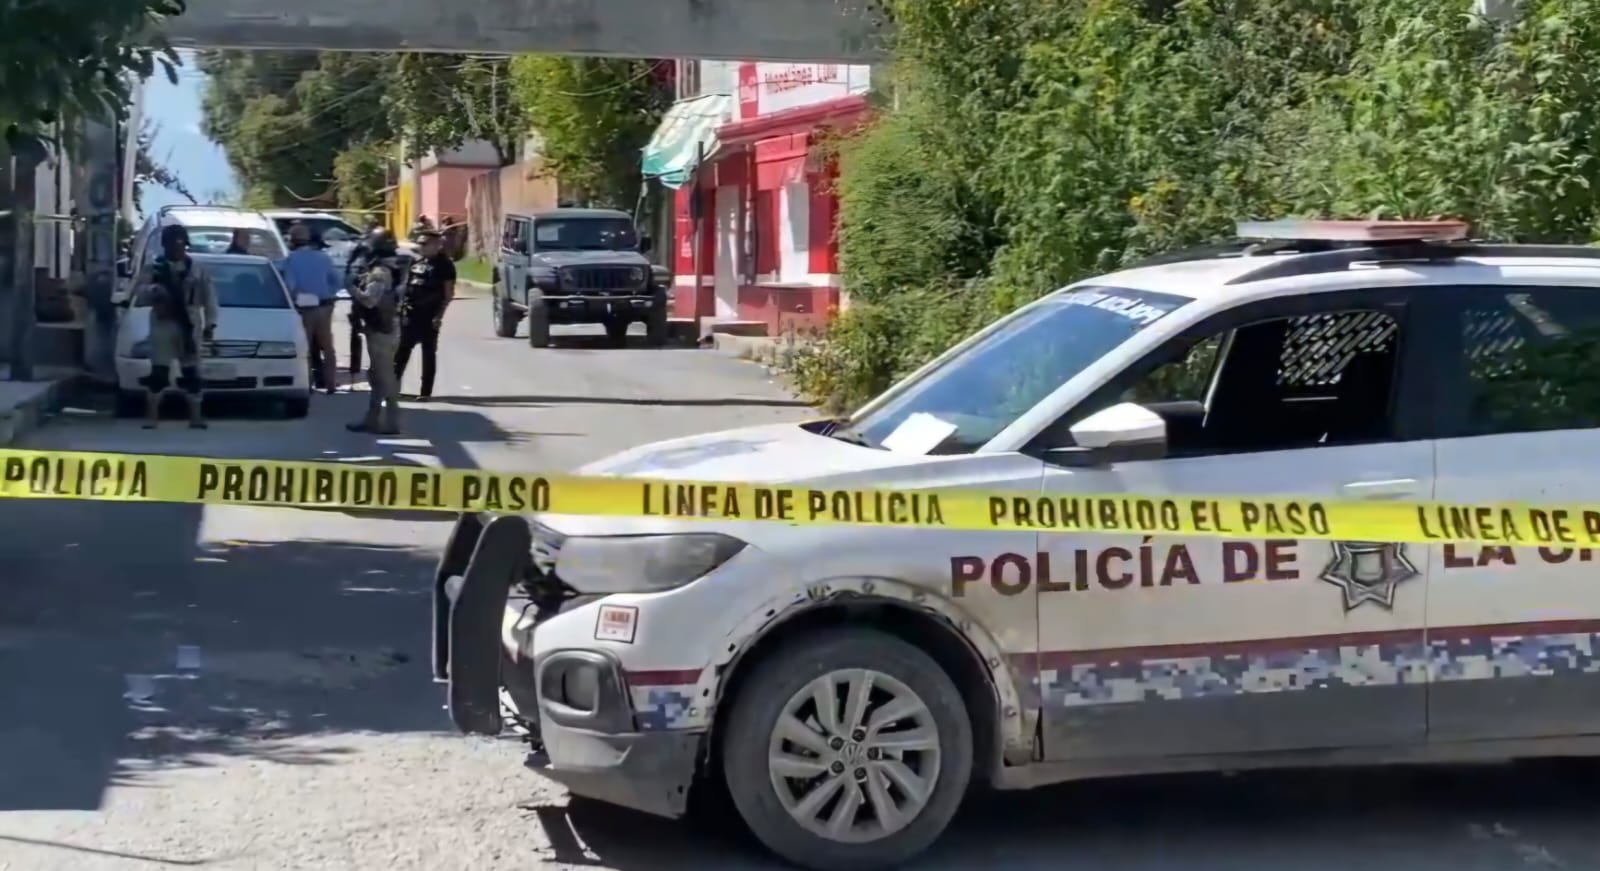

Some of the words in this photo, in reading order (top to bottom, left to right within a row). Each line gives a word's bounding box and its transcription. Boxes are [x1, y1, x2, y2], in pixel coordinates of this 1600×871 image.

[4, 456, 148, 498] POLICIA
[196, 463, 397, 506] PROHIBIDO
[410, 473, 447, 507] EL
[461, 475, 550, 511] PASO
[642, 483, 741, 518] LINEA
[754, 488, 795, 520] DE
[808, 489, 945, 524] POLICIA
[988, 497, 1181, 531] PROHIBIDO
[1190, 501, 1233, 532] EL
[1240, 502, 1331, 535] PASO
[1417, 505, 1523, 542] LINEA
[1528, 508, 1577, 543] DE
[950, 535, 1200, 597] POLICÍA
[1221, 539, 1300, 584] DE
